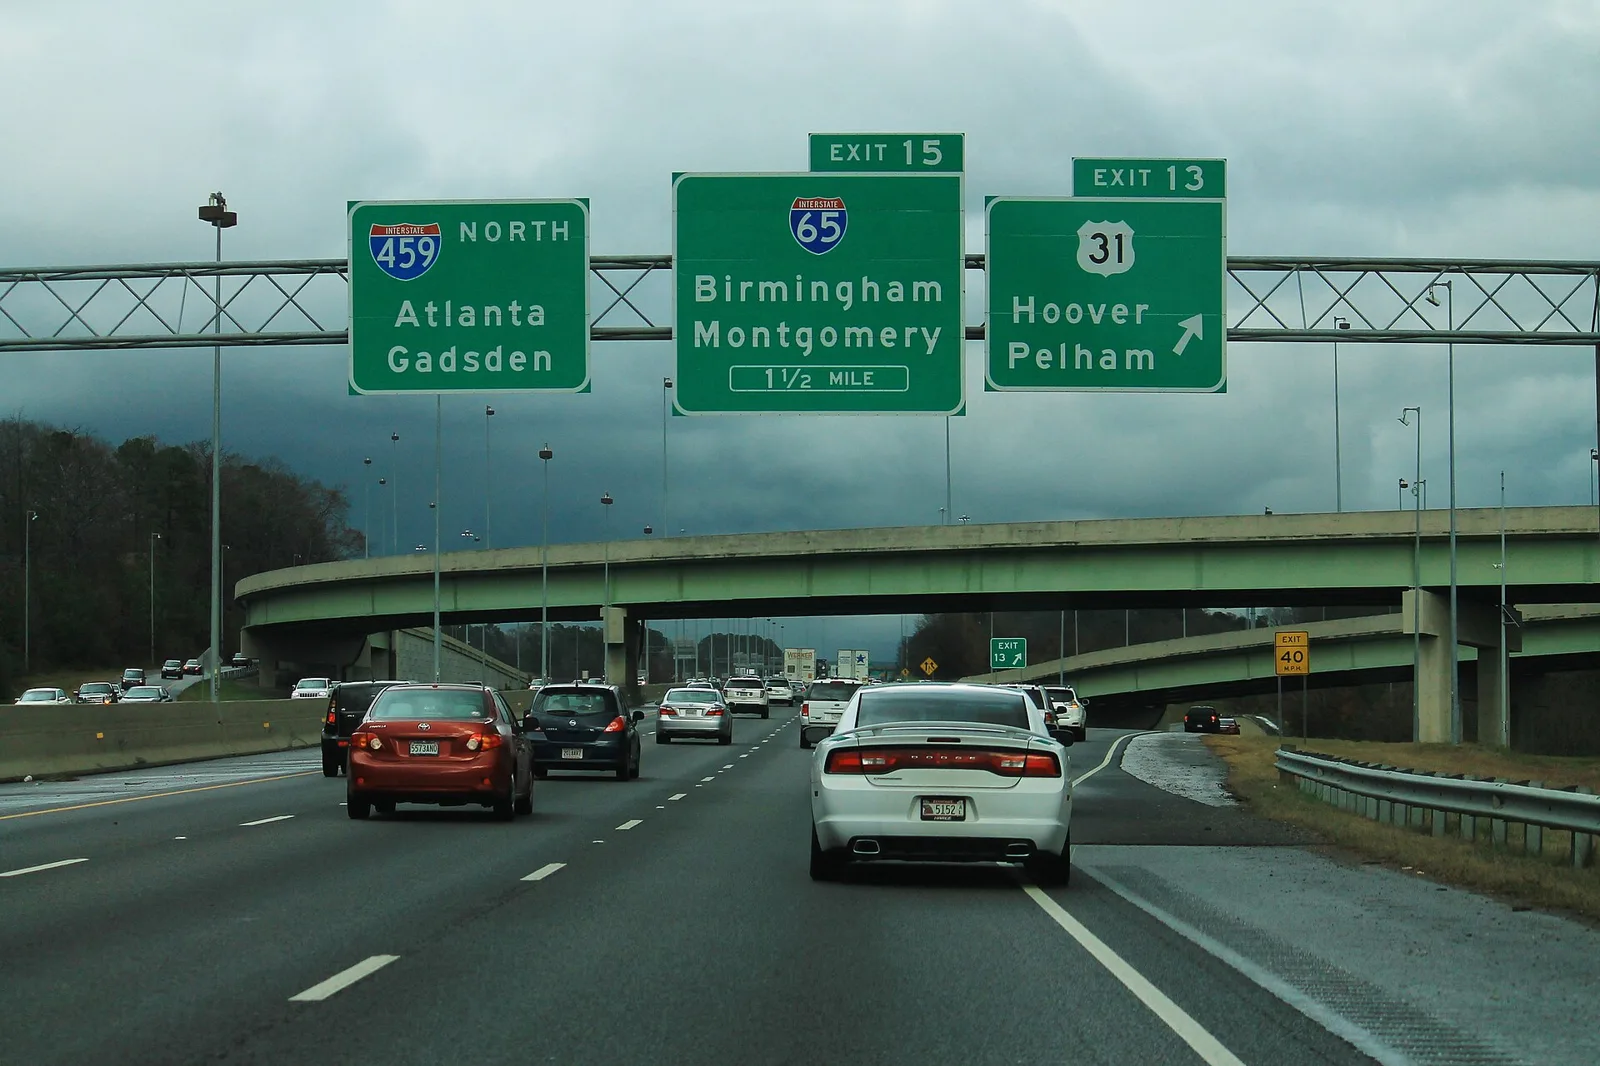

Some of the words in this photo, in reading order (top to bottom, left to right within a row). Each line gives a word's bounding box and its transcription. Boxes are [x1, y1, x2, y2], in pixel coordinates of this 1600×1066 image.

[830, 143, 888, 162] EXIT
[903, 139, 943, 166] 15
[1094, 168, 1152, 187] EXIT
[1166, 165, 1204, 191] 13
[798, 200, 838, 208] INTERSTATE
[385, 226, 425, 235] INTERSTATE
[460, 220, 569, 243] NORTH
[796, 211, 841, 243] 65
[376, 236, 435, 269] 459
[1088, 232, 1123, 264] 31
[695, 274, 942, 311] Birmingham
[394, 299, 545, 328] Atlanta
[1012, 295, 1150, 325] Hoover
[694, 320, 942, 357] Montgomery
[387, 344, 552, 374] Gadsden
[1008, 341, 1154, 370] Pelham
[829, 371, 874, 386] MILE
[998, 641, 1018, 650] EXIT
[1282, 635, 1301, 643] EXIT
[994, 653, 1006, 662] 13
[1280, 650, 1304, 663] 40
